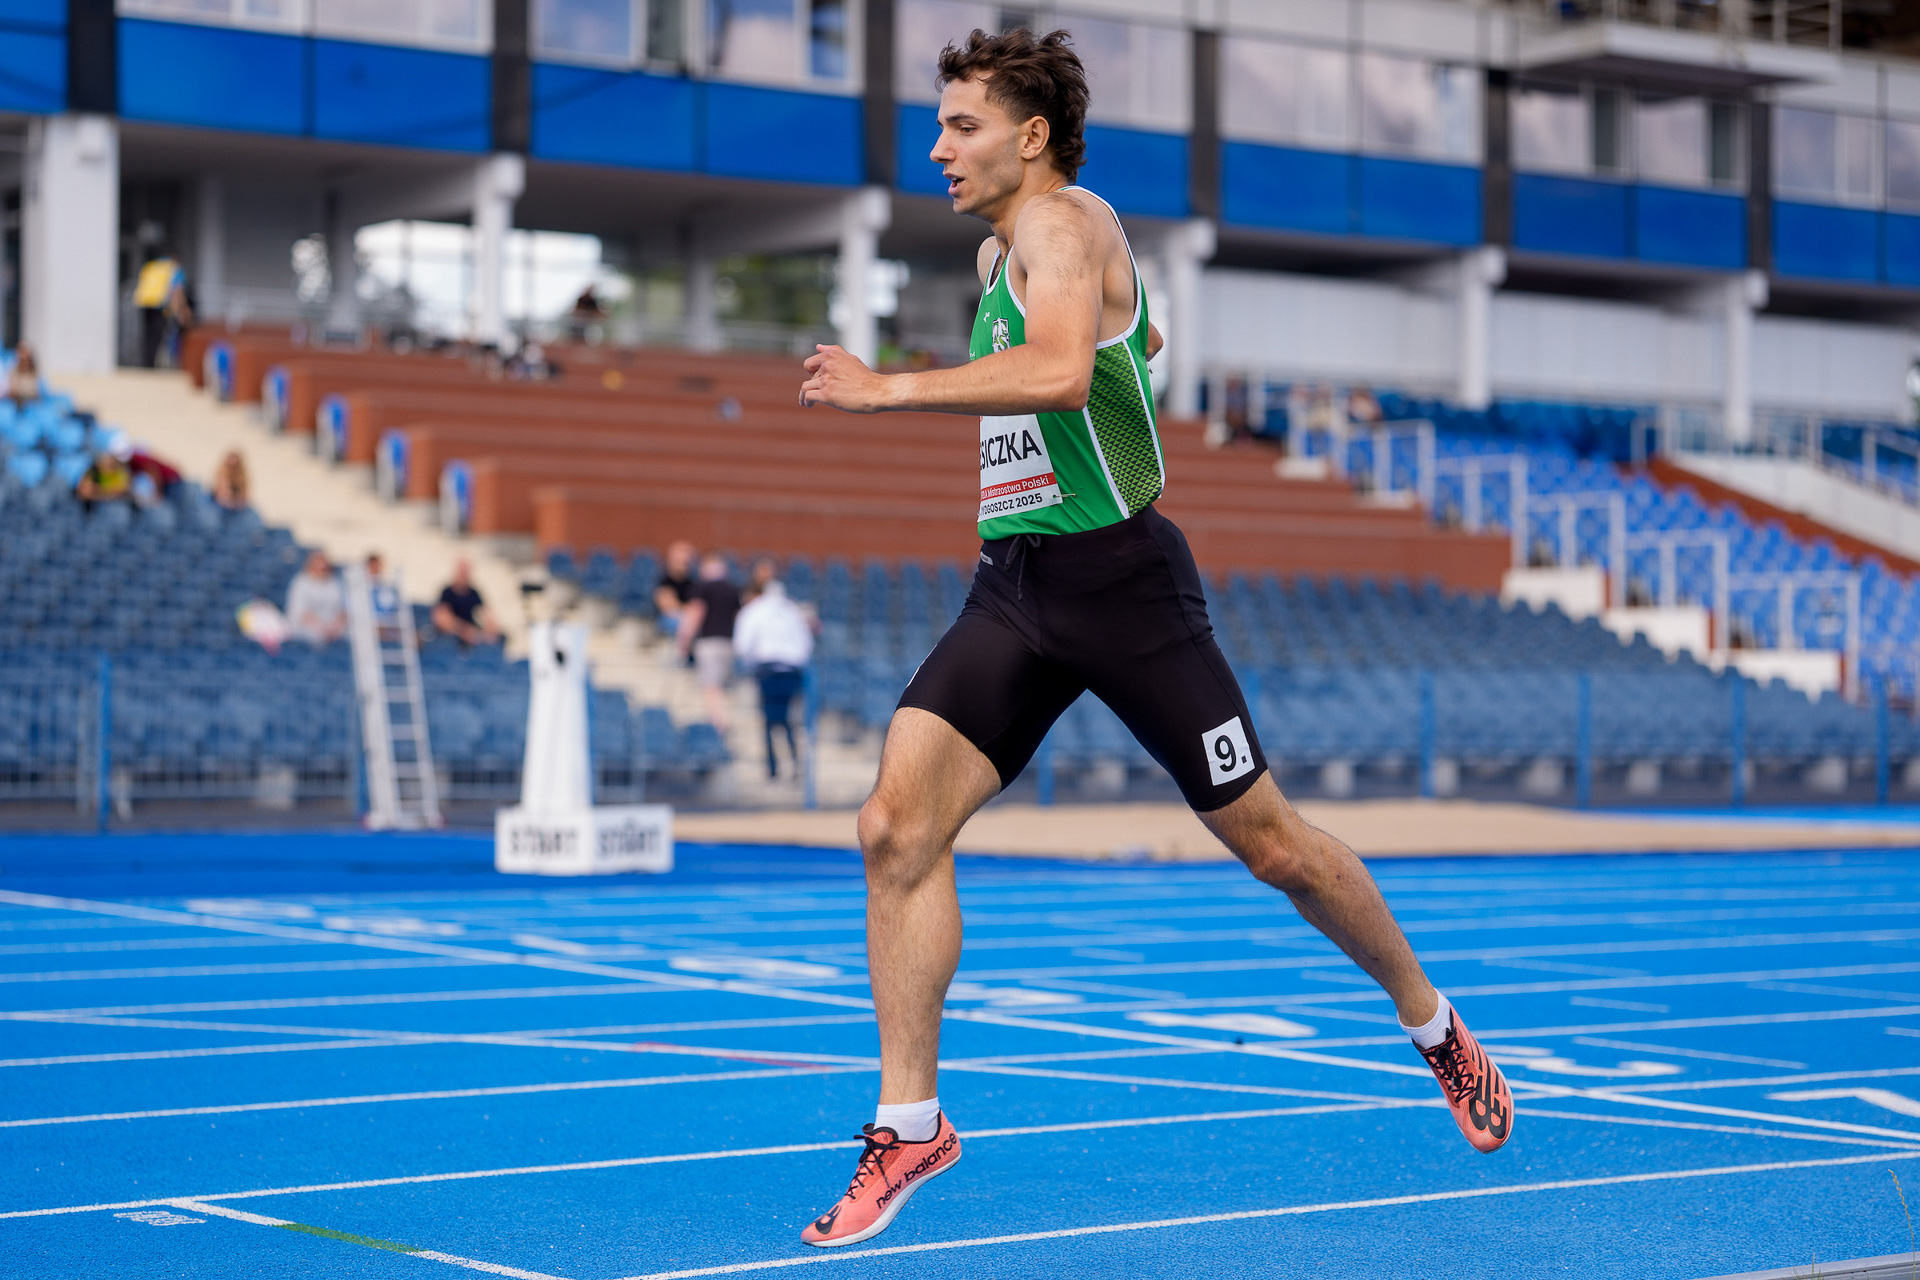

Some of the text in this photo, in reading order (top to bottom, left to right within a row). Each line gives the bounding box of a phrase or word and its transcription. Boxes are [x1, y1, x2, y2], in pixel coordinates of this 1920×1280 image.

[980, 429, 1042, 470] SICZKA
[1022, 475, 1050, 489] Polski
[980, 492, 1043, 516] YDGOSZCZ 2025
[876, 1132, 958, 1210] new balance
